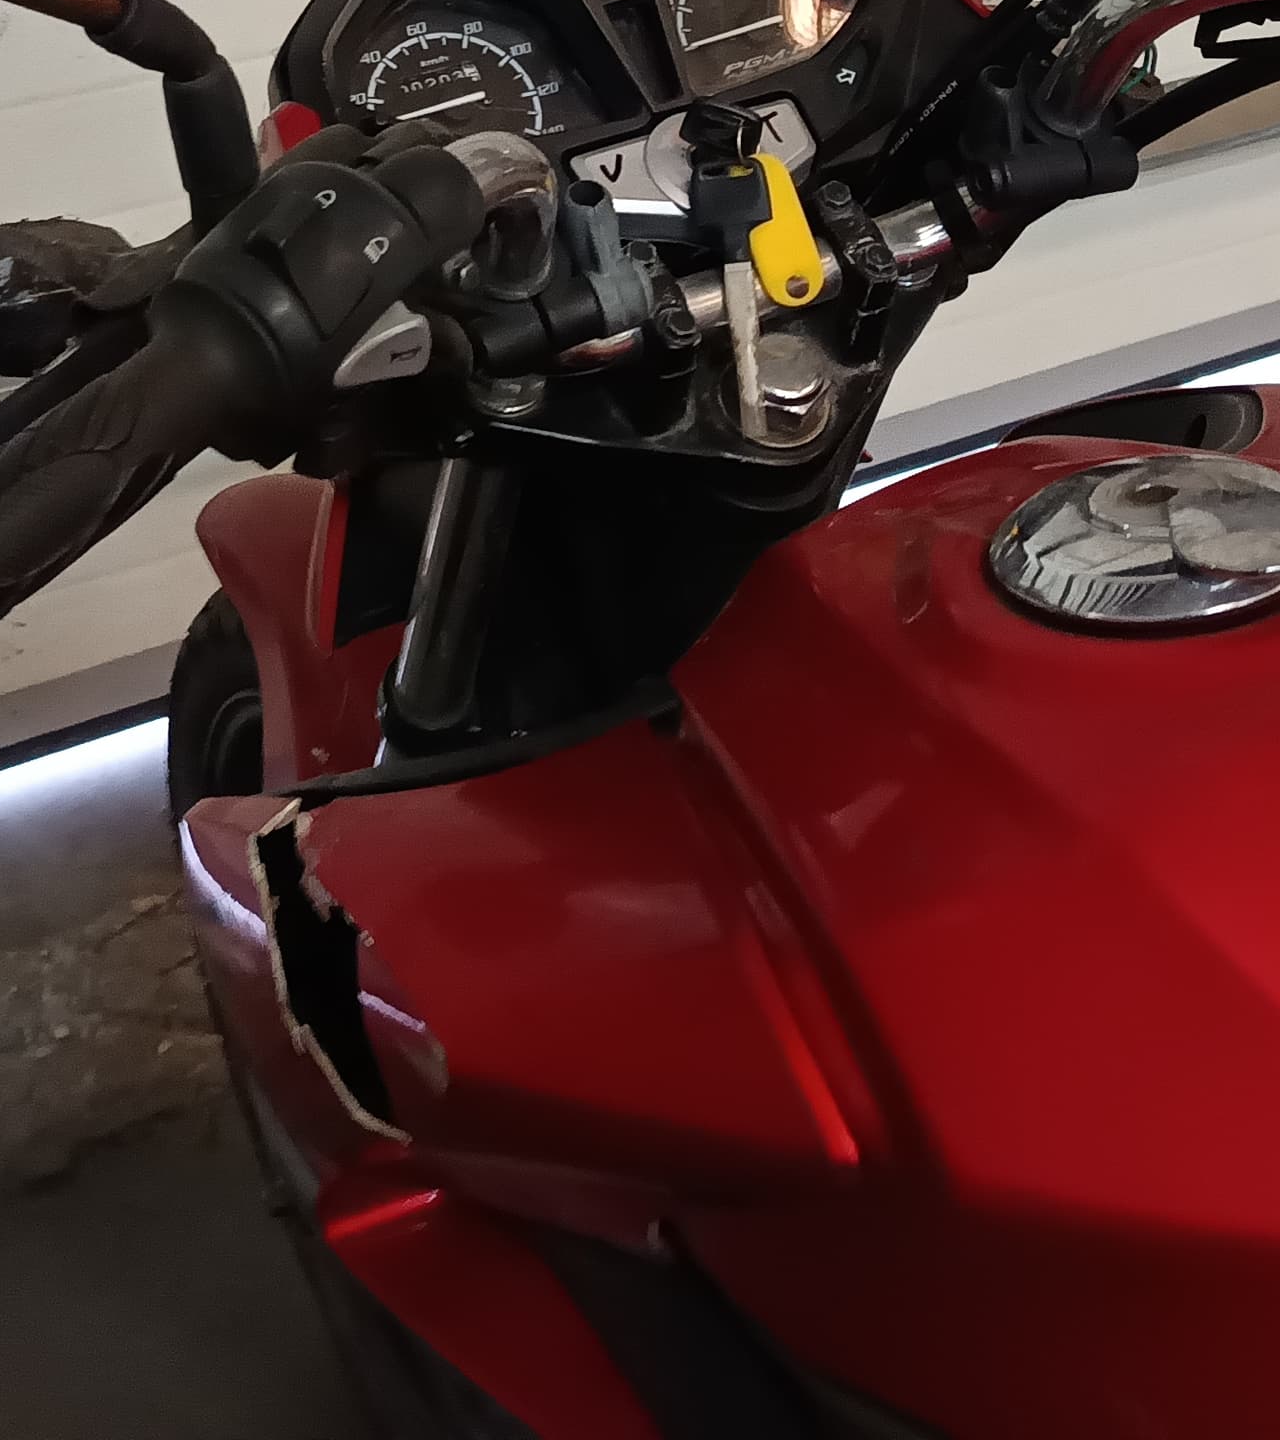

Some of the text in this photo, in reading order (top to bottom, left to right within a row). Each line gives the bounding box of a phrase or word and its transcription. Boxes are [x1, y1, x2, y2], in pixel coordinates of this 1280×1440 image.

[406, 21, 428, 35] 60
[463, 20, 485, 35] 80
[509, 42, 532, 56] 100
[360, 49, 382, 65] 40
[536, 81, 560, 97] 120
